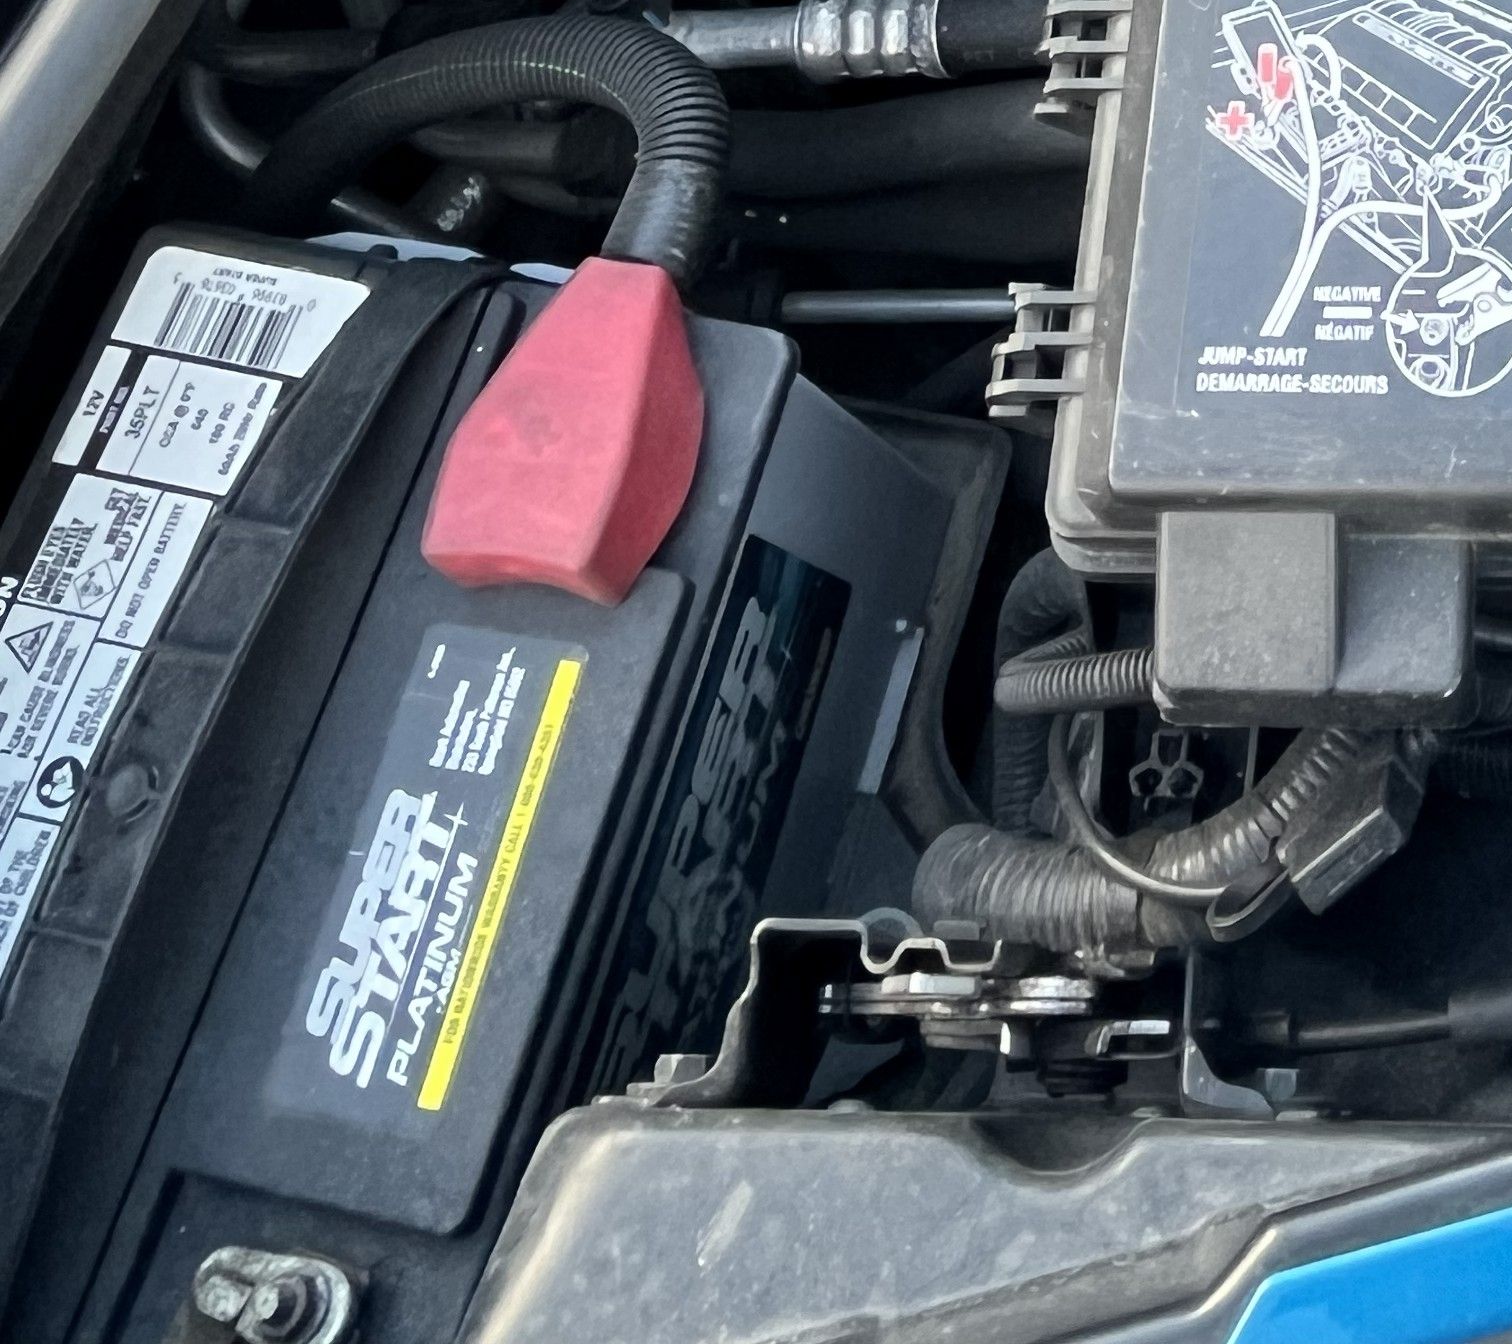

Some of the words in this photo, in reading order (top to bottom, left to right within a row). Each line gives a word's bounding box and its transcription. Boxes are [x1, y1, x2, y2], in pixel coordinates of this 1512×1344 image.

[1313, 285, 1381, 301] NEGATIVE
[1197, 346, 1307, 365] JUMP-START
[82, 388, 105, 418] 12V
[503, 821, 522, 854] CALL
[299, 786, 423, 1044] SUPER
[321, 787, 464, 1089] START
[381, 851, 480, 1086] PLATINUM
